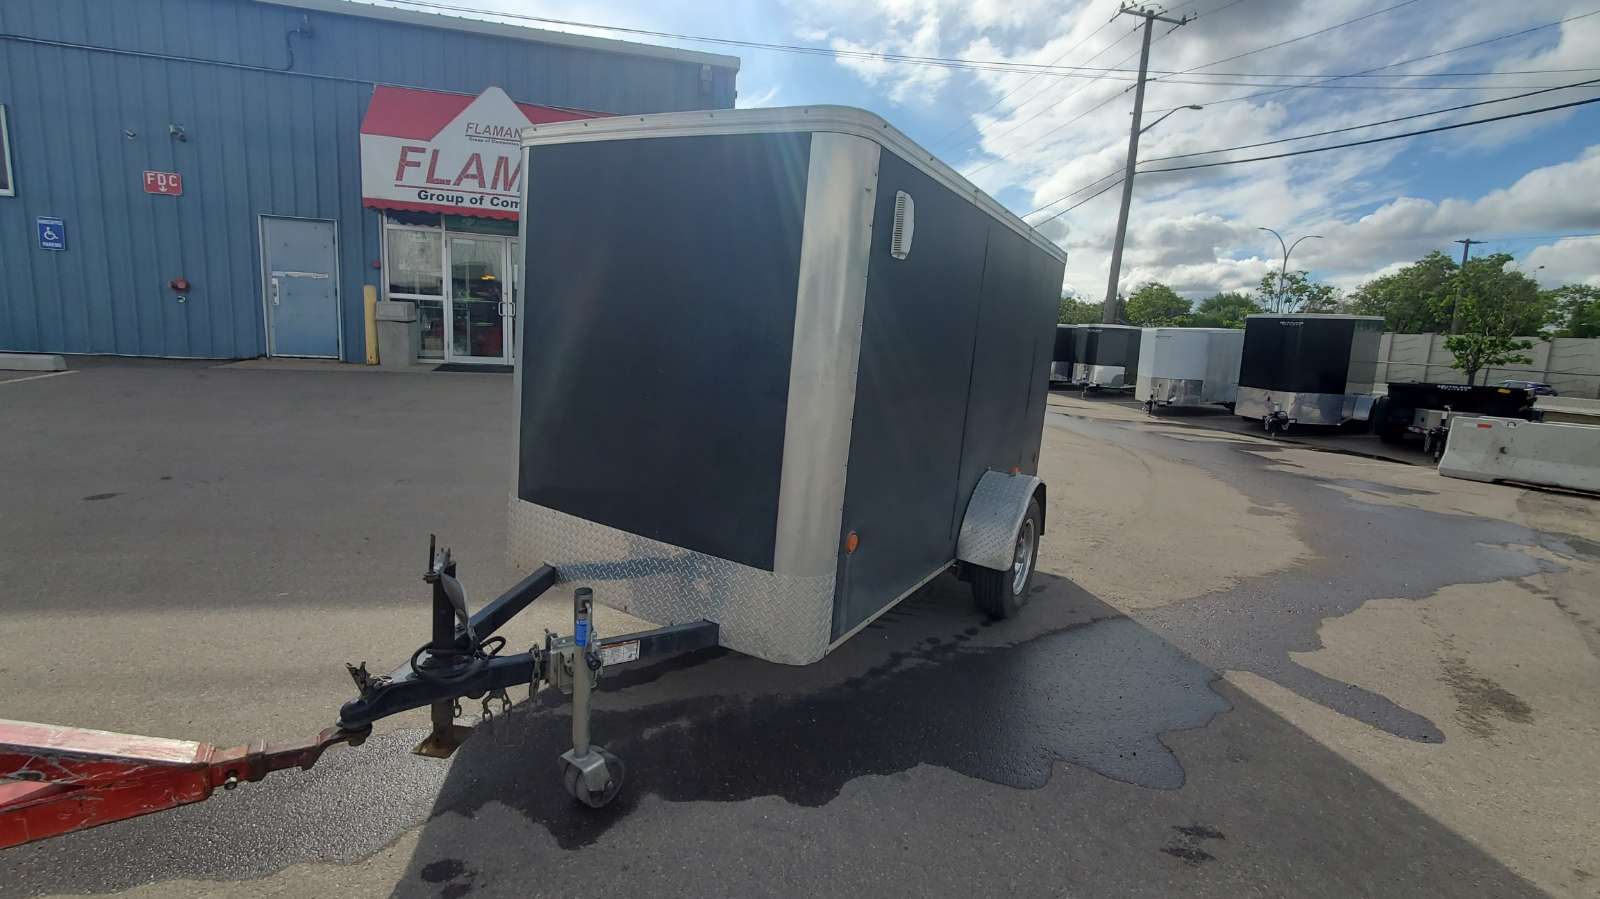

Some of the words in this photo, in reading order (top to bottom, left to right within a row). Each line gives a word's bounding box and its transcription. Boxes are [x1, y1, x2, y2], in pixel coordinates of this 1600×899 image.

[395, 145, 520, 192] FLAM
[147, 173, 178, 187] FDC
[417, 189, 464, 205] Group
[469, 195, 486, 205] of
